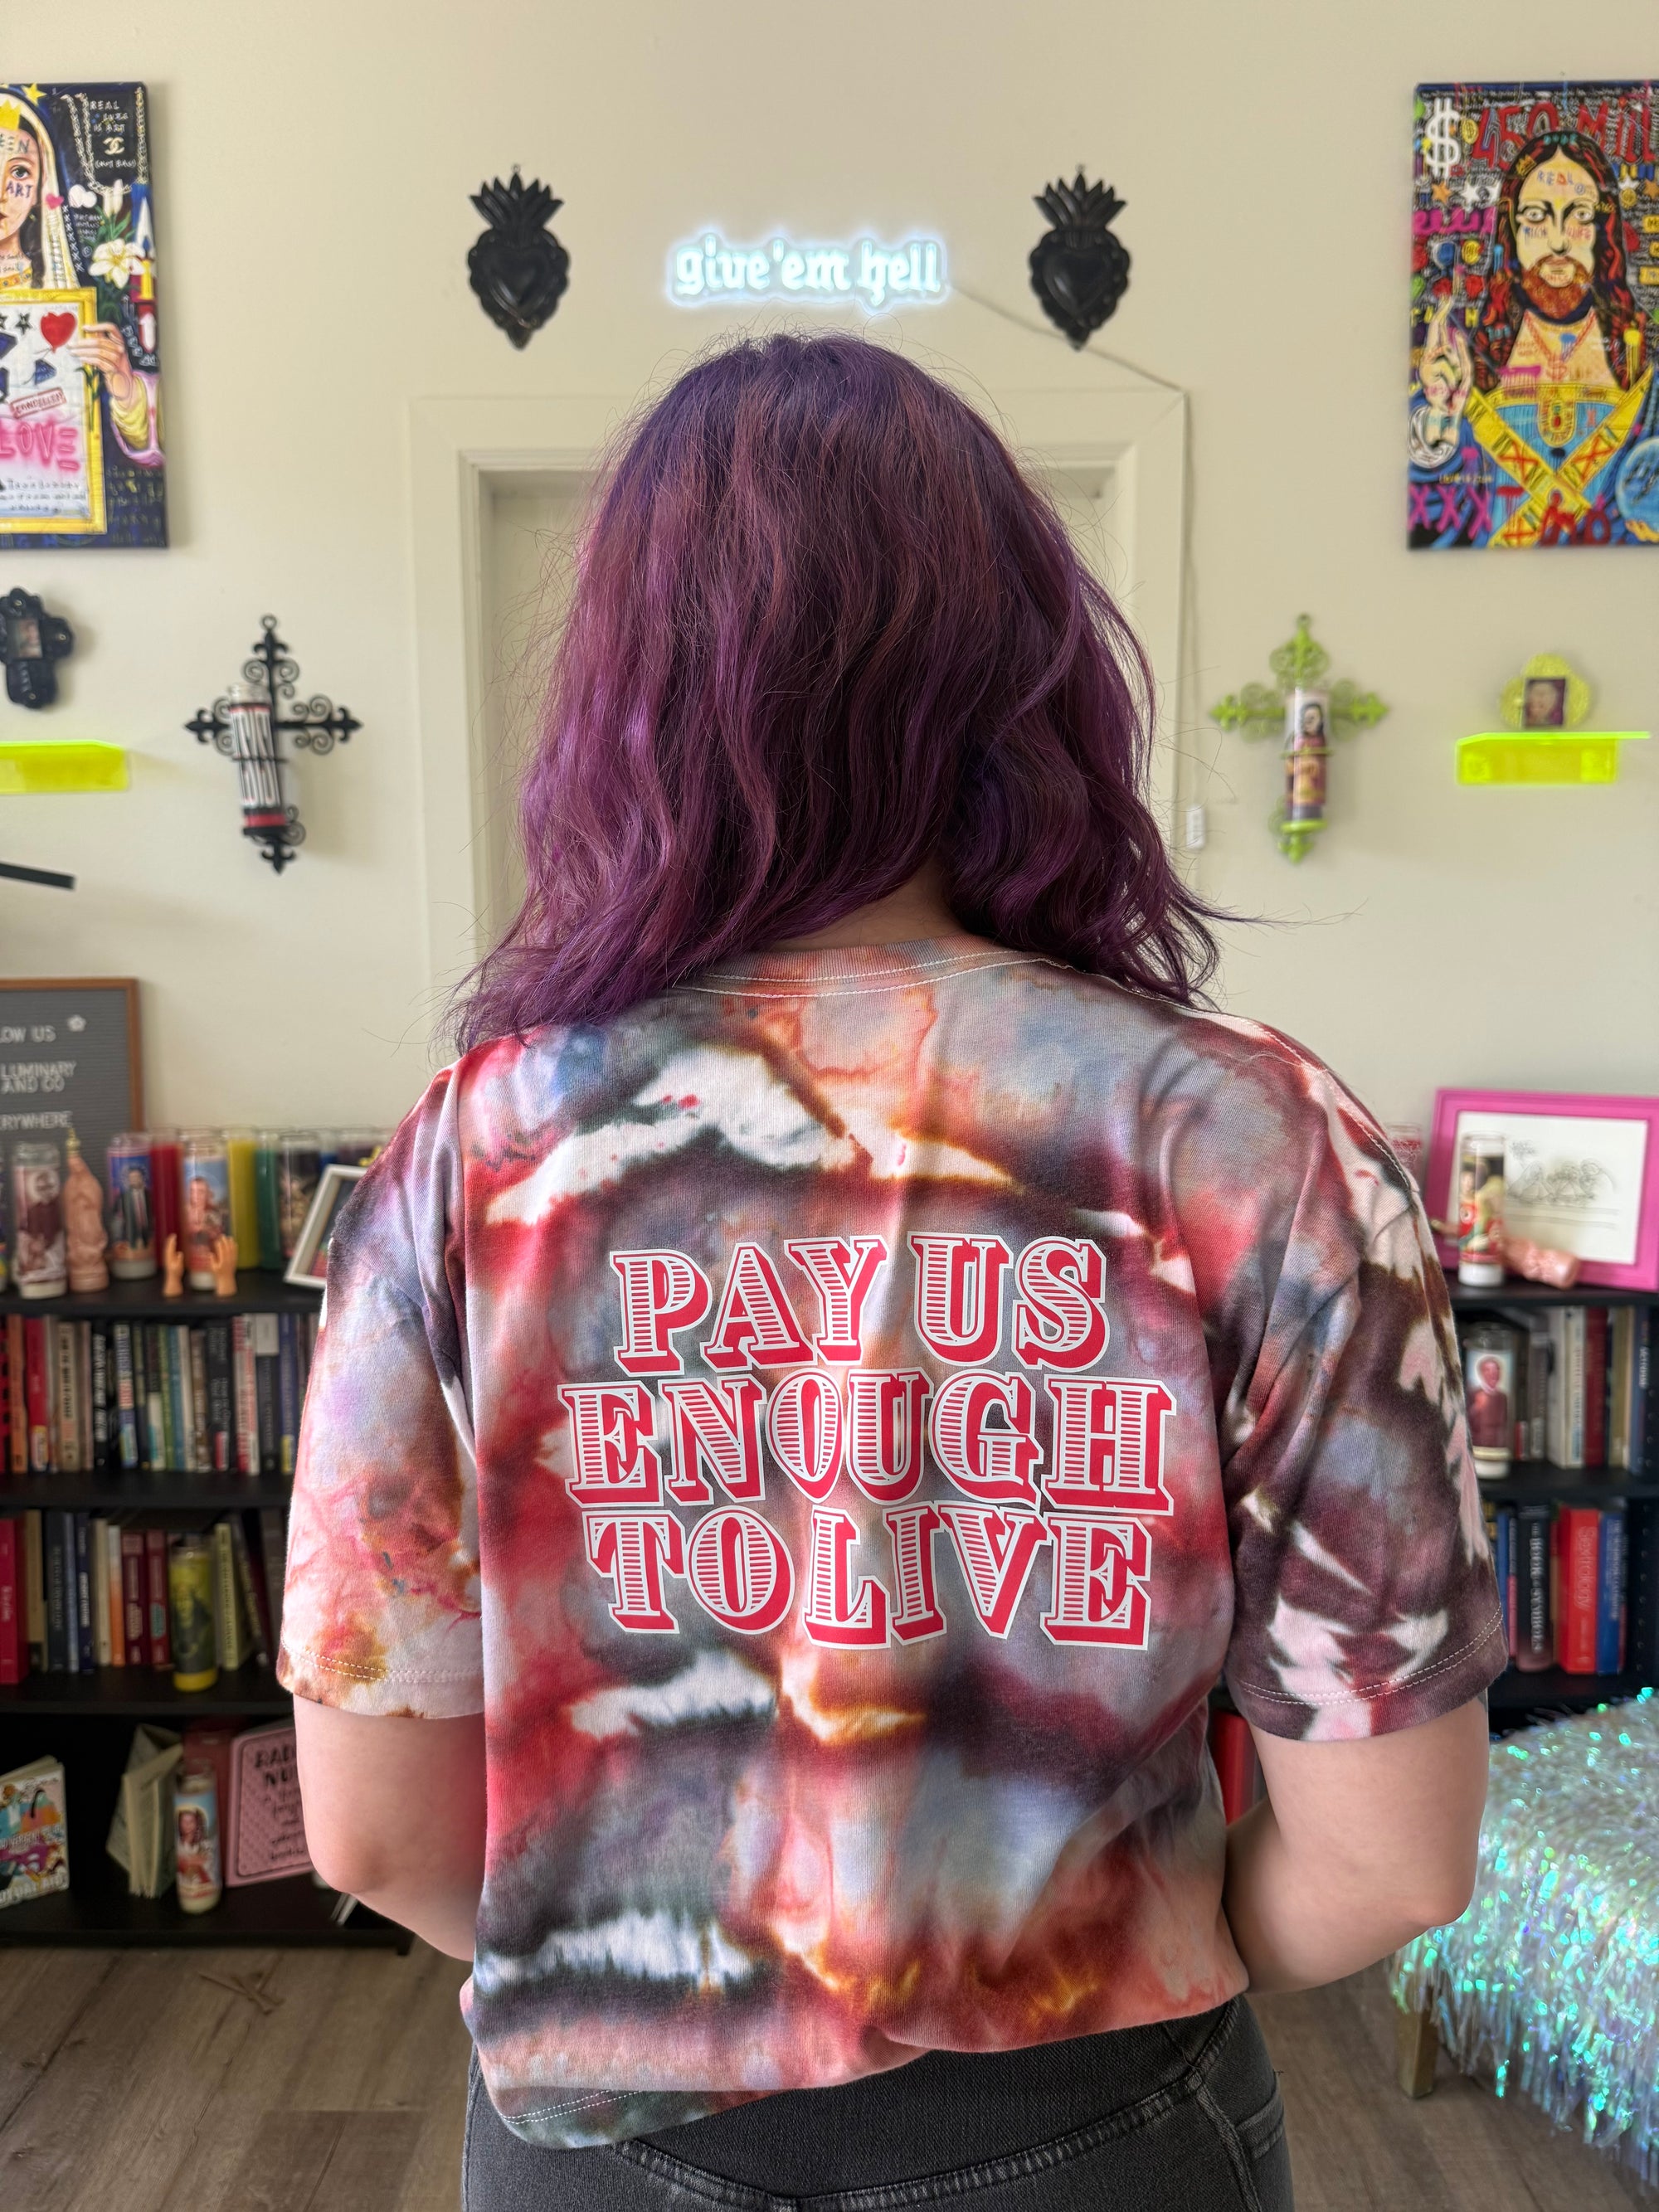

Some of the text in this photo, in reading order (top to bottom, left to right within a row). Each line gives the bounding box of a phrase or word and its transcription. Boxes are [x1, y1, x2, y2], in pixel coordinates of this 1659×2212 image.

[90, 100, 120, 110] REAL
[6, 180, 33, 199] ART
[857, 239, 941, 306] hell
[0, 1025, 56, 1043] OW US
[0, 1111, 74, 1131] RYWHERE
[609, 1231, 1110, 1377] PAY US
[557, 1368, 1177, 1516] ENOUGH
[586, 1500, 1153, 1651] TO LIVE
